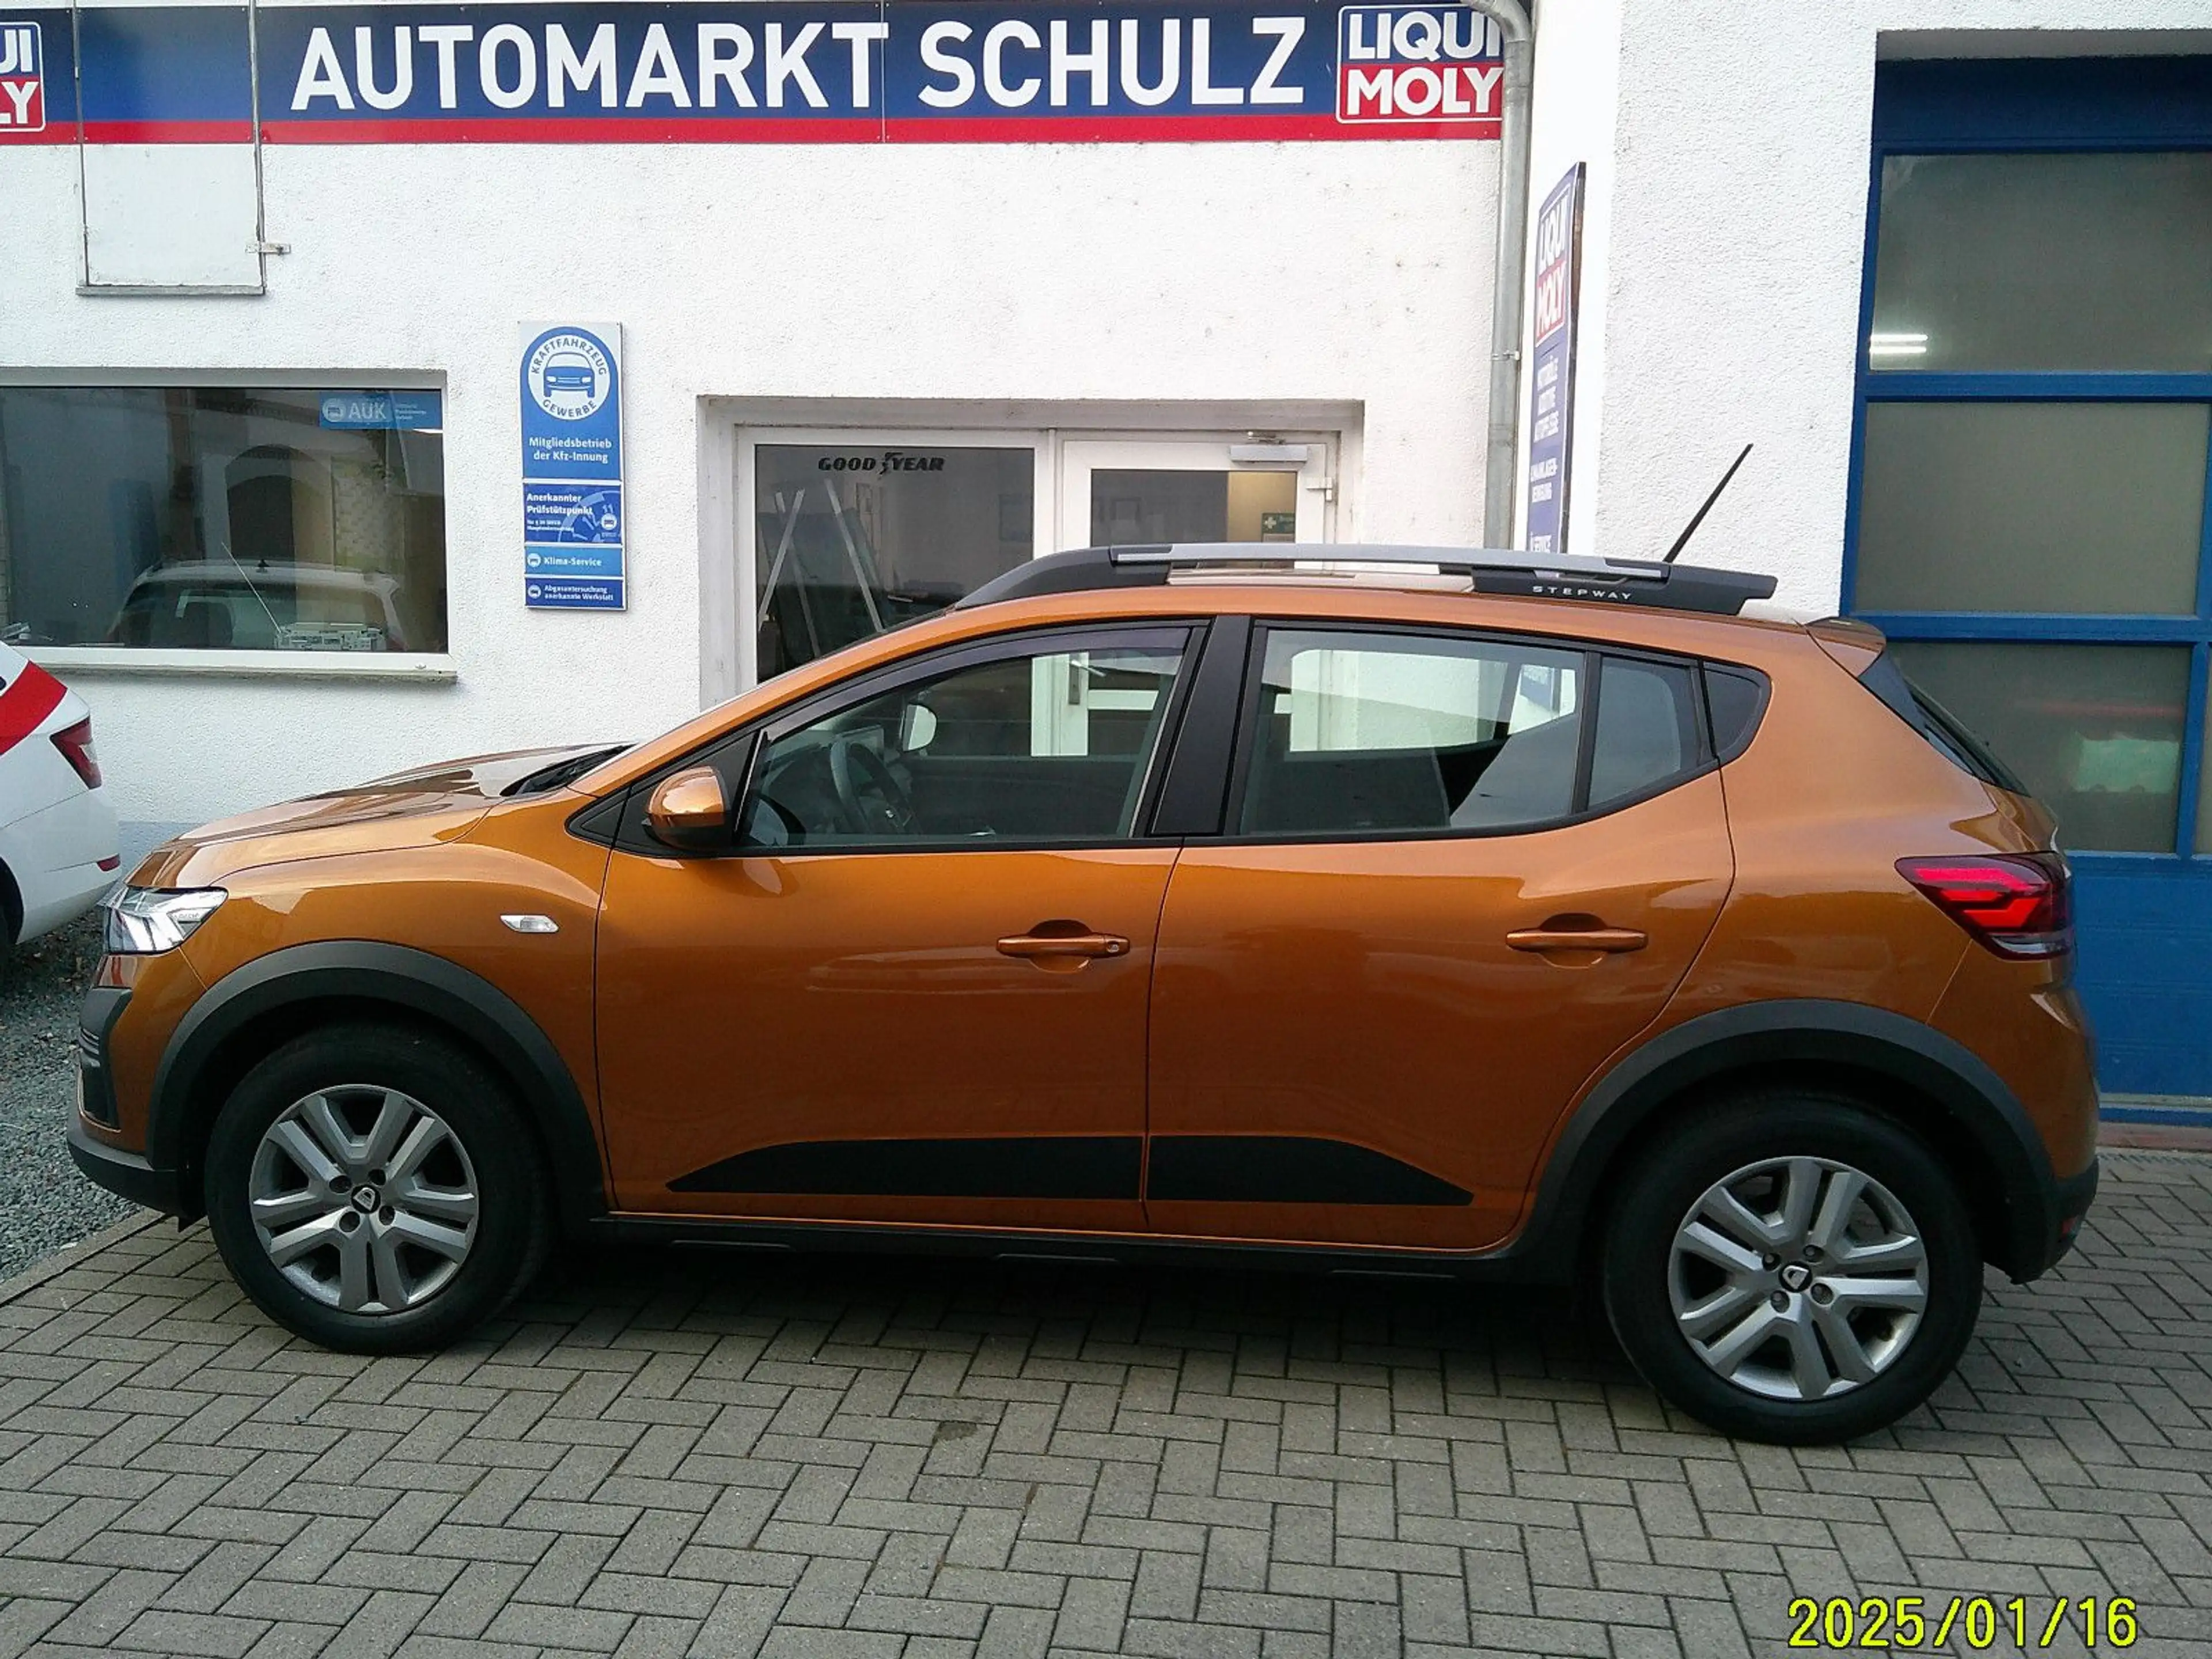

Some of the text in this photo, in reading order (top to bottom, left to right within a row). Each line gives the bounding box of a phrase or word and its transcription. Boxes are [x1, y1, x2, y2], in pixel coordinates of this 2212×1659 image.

[1349, 11, 1501, 61] LIQUI
[291, 16, 1305, 110] AUTOMARKT SCHULZ
[1347, 67, 1503, 115] MOLY
[531, 337, 607, 376] KRAFTFAHRZEUG
[543, 399, 597, 417] GEWERBE
[529, 437, 612, 449] Mitgliedsbetrieb
[533, 450, 608, 464] der Kfz-Innung
[527, 493, 582, 502] Anerkannter
[544, 555, 602, 566] Klima-Service
[1532, 585, 1632, 600] STEPWAY
